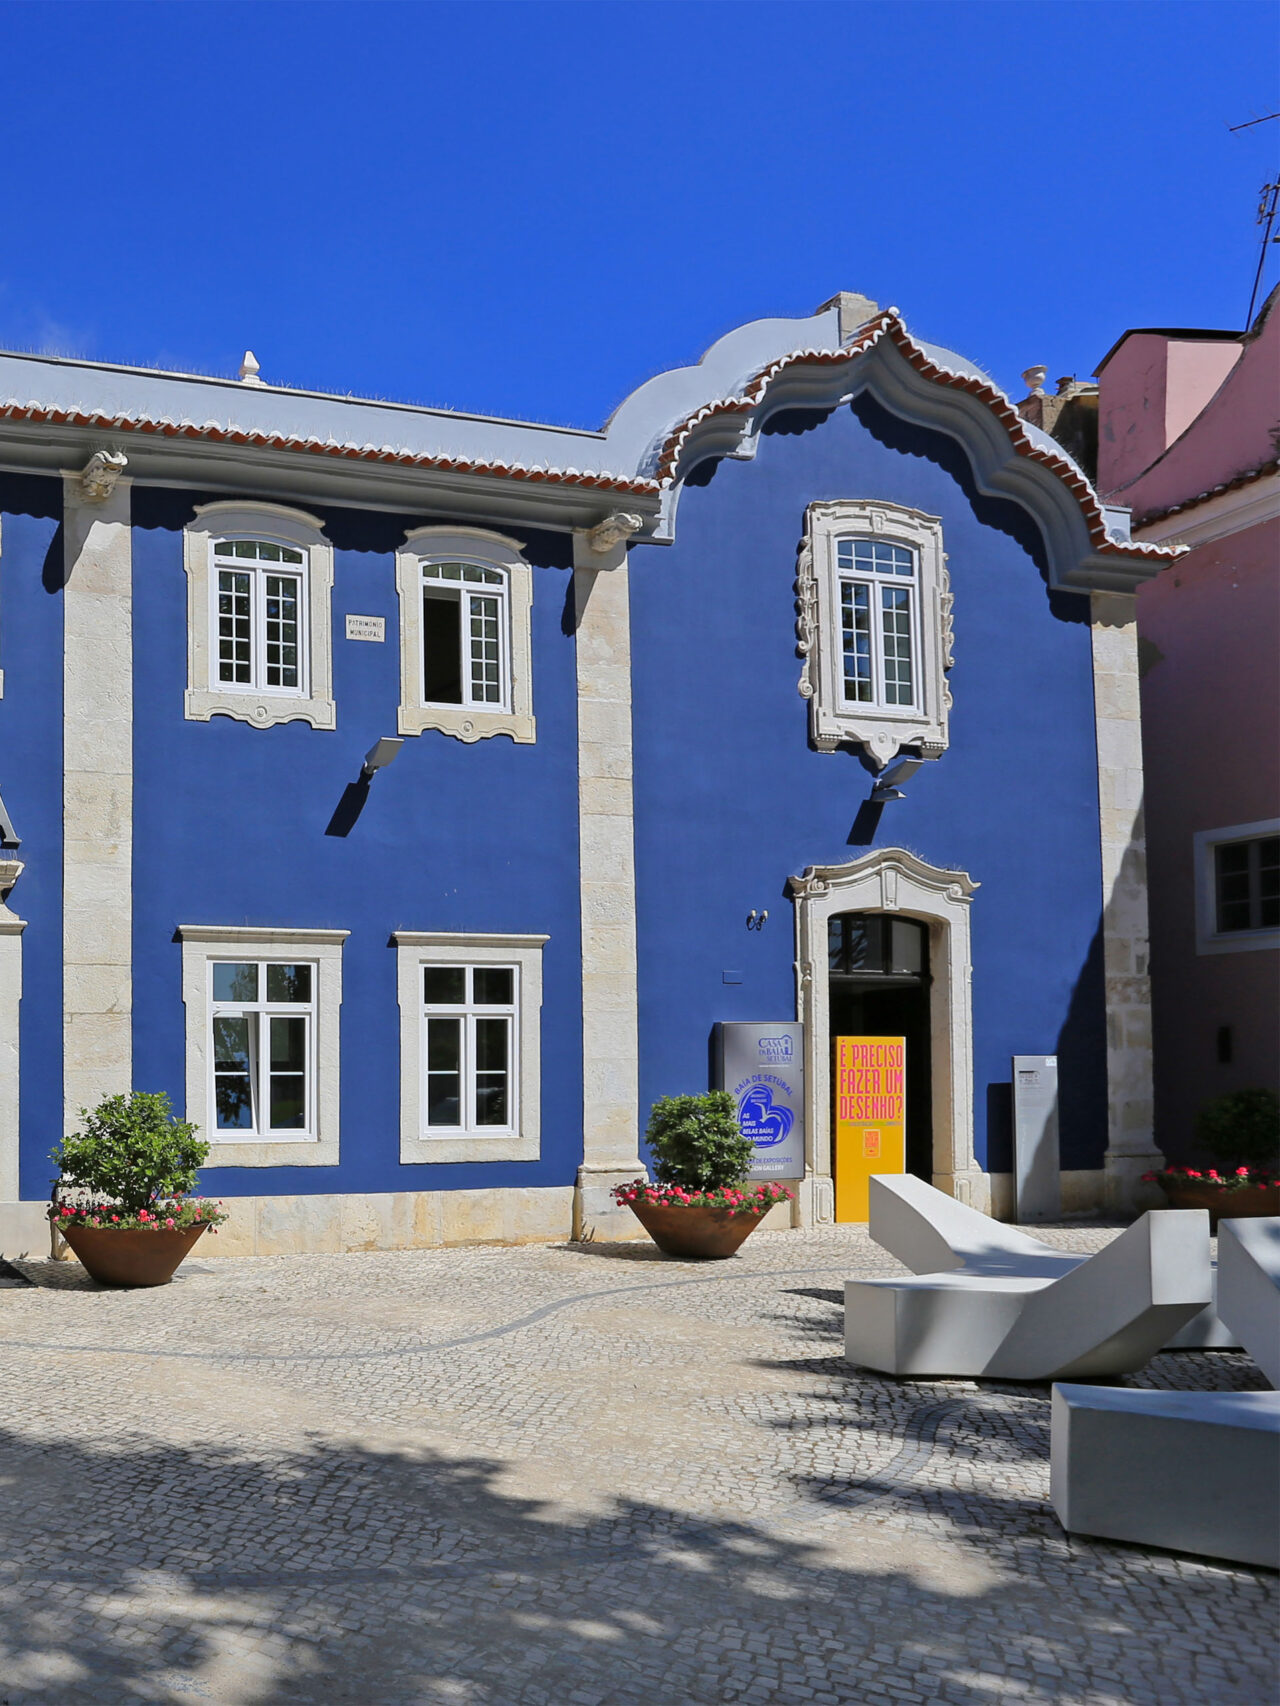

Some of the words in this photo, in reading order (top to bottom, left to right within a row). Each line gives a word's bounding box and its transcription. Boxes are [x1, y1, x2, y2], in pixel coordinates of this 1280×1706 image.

[350, 630, 381, 638] MUNICIPAL
[840, 1039, 847, 1068] É
[851, 1044, 904, 1068] PRECISO
[751, 1074, 762, 1083] DE
[840, 1069, 881, 1094] FAZER
[885, 1069, 904, 1094] UM
[840, 1095, 904, 1120] DESENHO?
[742, 1127, 759, 1135] BELAS
